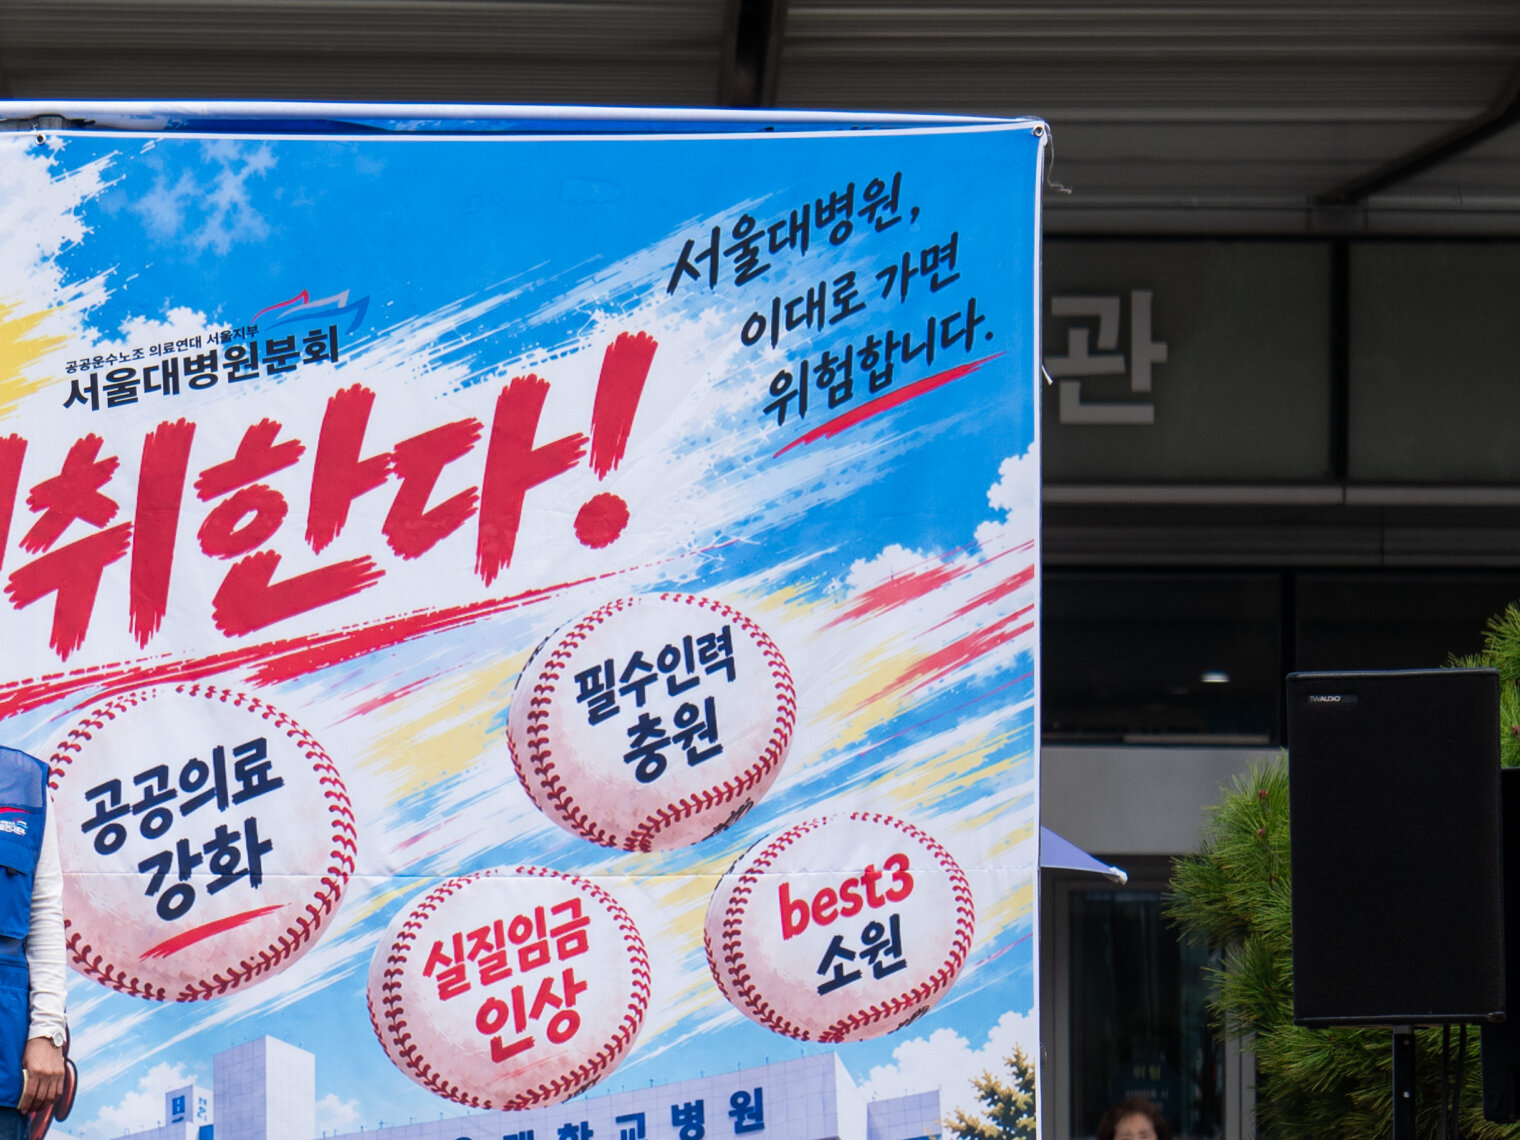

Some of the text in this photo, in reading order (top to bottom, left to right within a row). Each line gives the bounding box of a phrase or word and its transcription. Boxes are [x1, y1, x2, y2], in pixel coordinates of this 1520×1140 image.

[667, 171, 920, 296] 서울대병원,
[741, 231, 960, 349] 이대로 가면
[63, 324, 339, 411] 서울대병원분회
[65, 324, 259, 374] 공공운수노조 의료연대 서울지부
[763, 297, 993, 426] 위험합니다.
[1046, 290, 1167, 424] 관
[574, 625, 737, 726] 필수인력
[623, 695, 723, 784] 충원
[80, 736, 284, 856] 공공의료
[138, 816, 273, 921] 강화
[777, 852, 915, 942] best3
[422, 897, 590, 1002] 실질임금
[816, 913, 908, 997] 소원
[474, 966, 588, 1064] 인상
